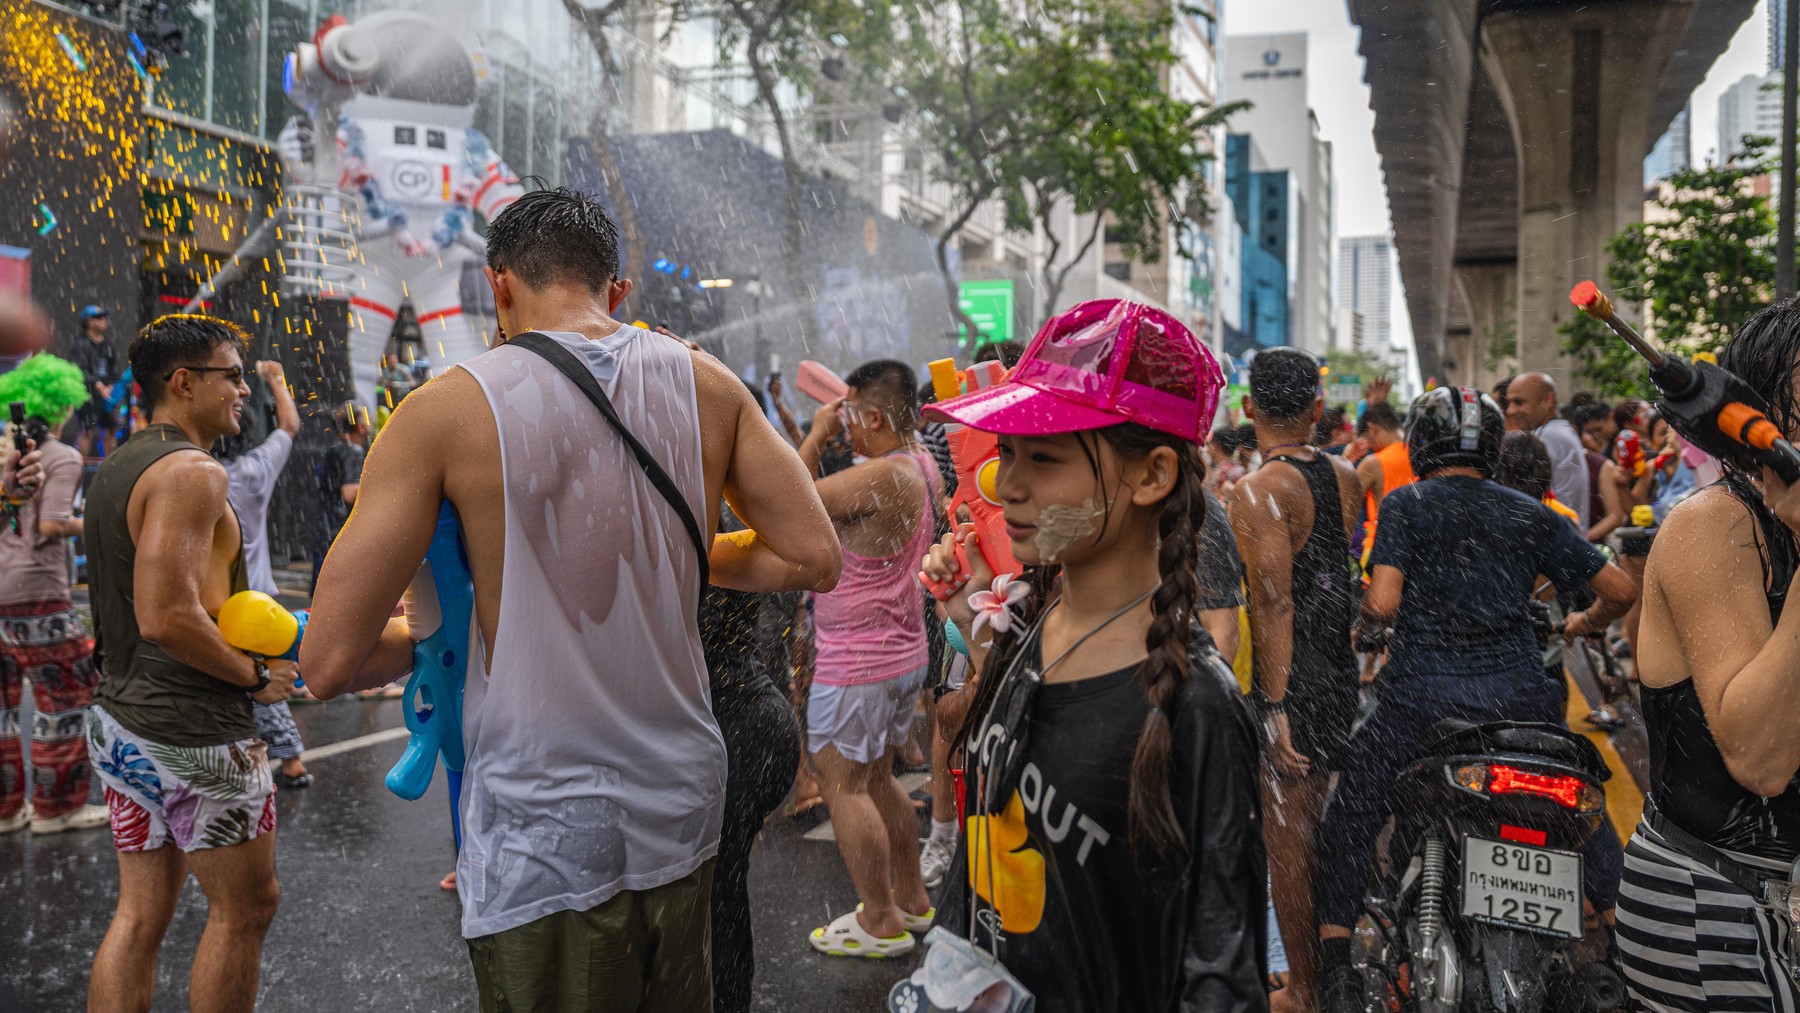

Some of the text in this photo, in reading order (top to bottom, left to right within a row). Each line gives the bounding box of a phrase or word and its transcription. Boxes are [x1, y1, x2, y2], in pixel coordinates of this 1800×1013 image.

[398, 170, 428, 188] CP
[1019, 761, 1111, 868] OUT
[1491, 845, 1552, 876] 8ขอ
[1469, 871, 1575, 903] กรุงเทพมหานคร
[1483, 894, 1563, 930] 1257
